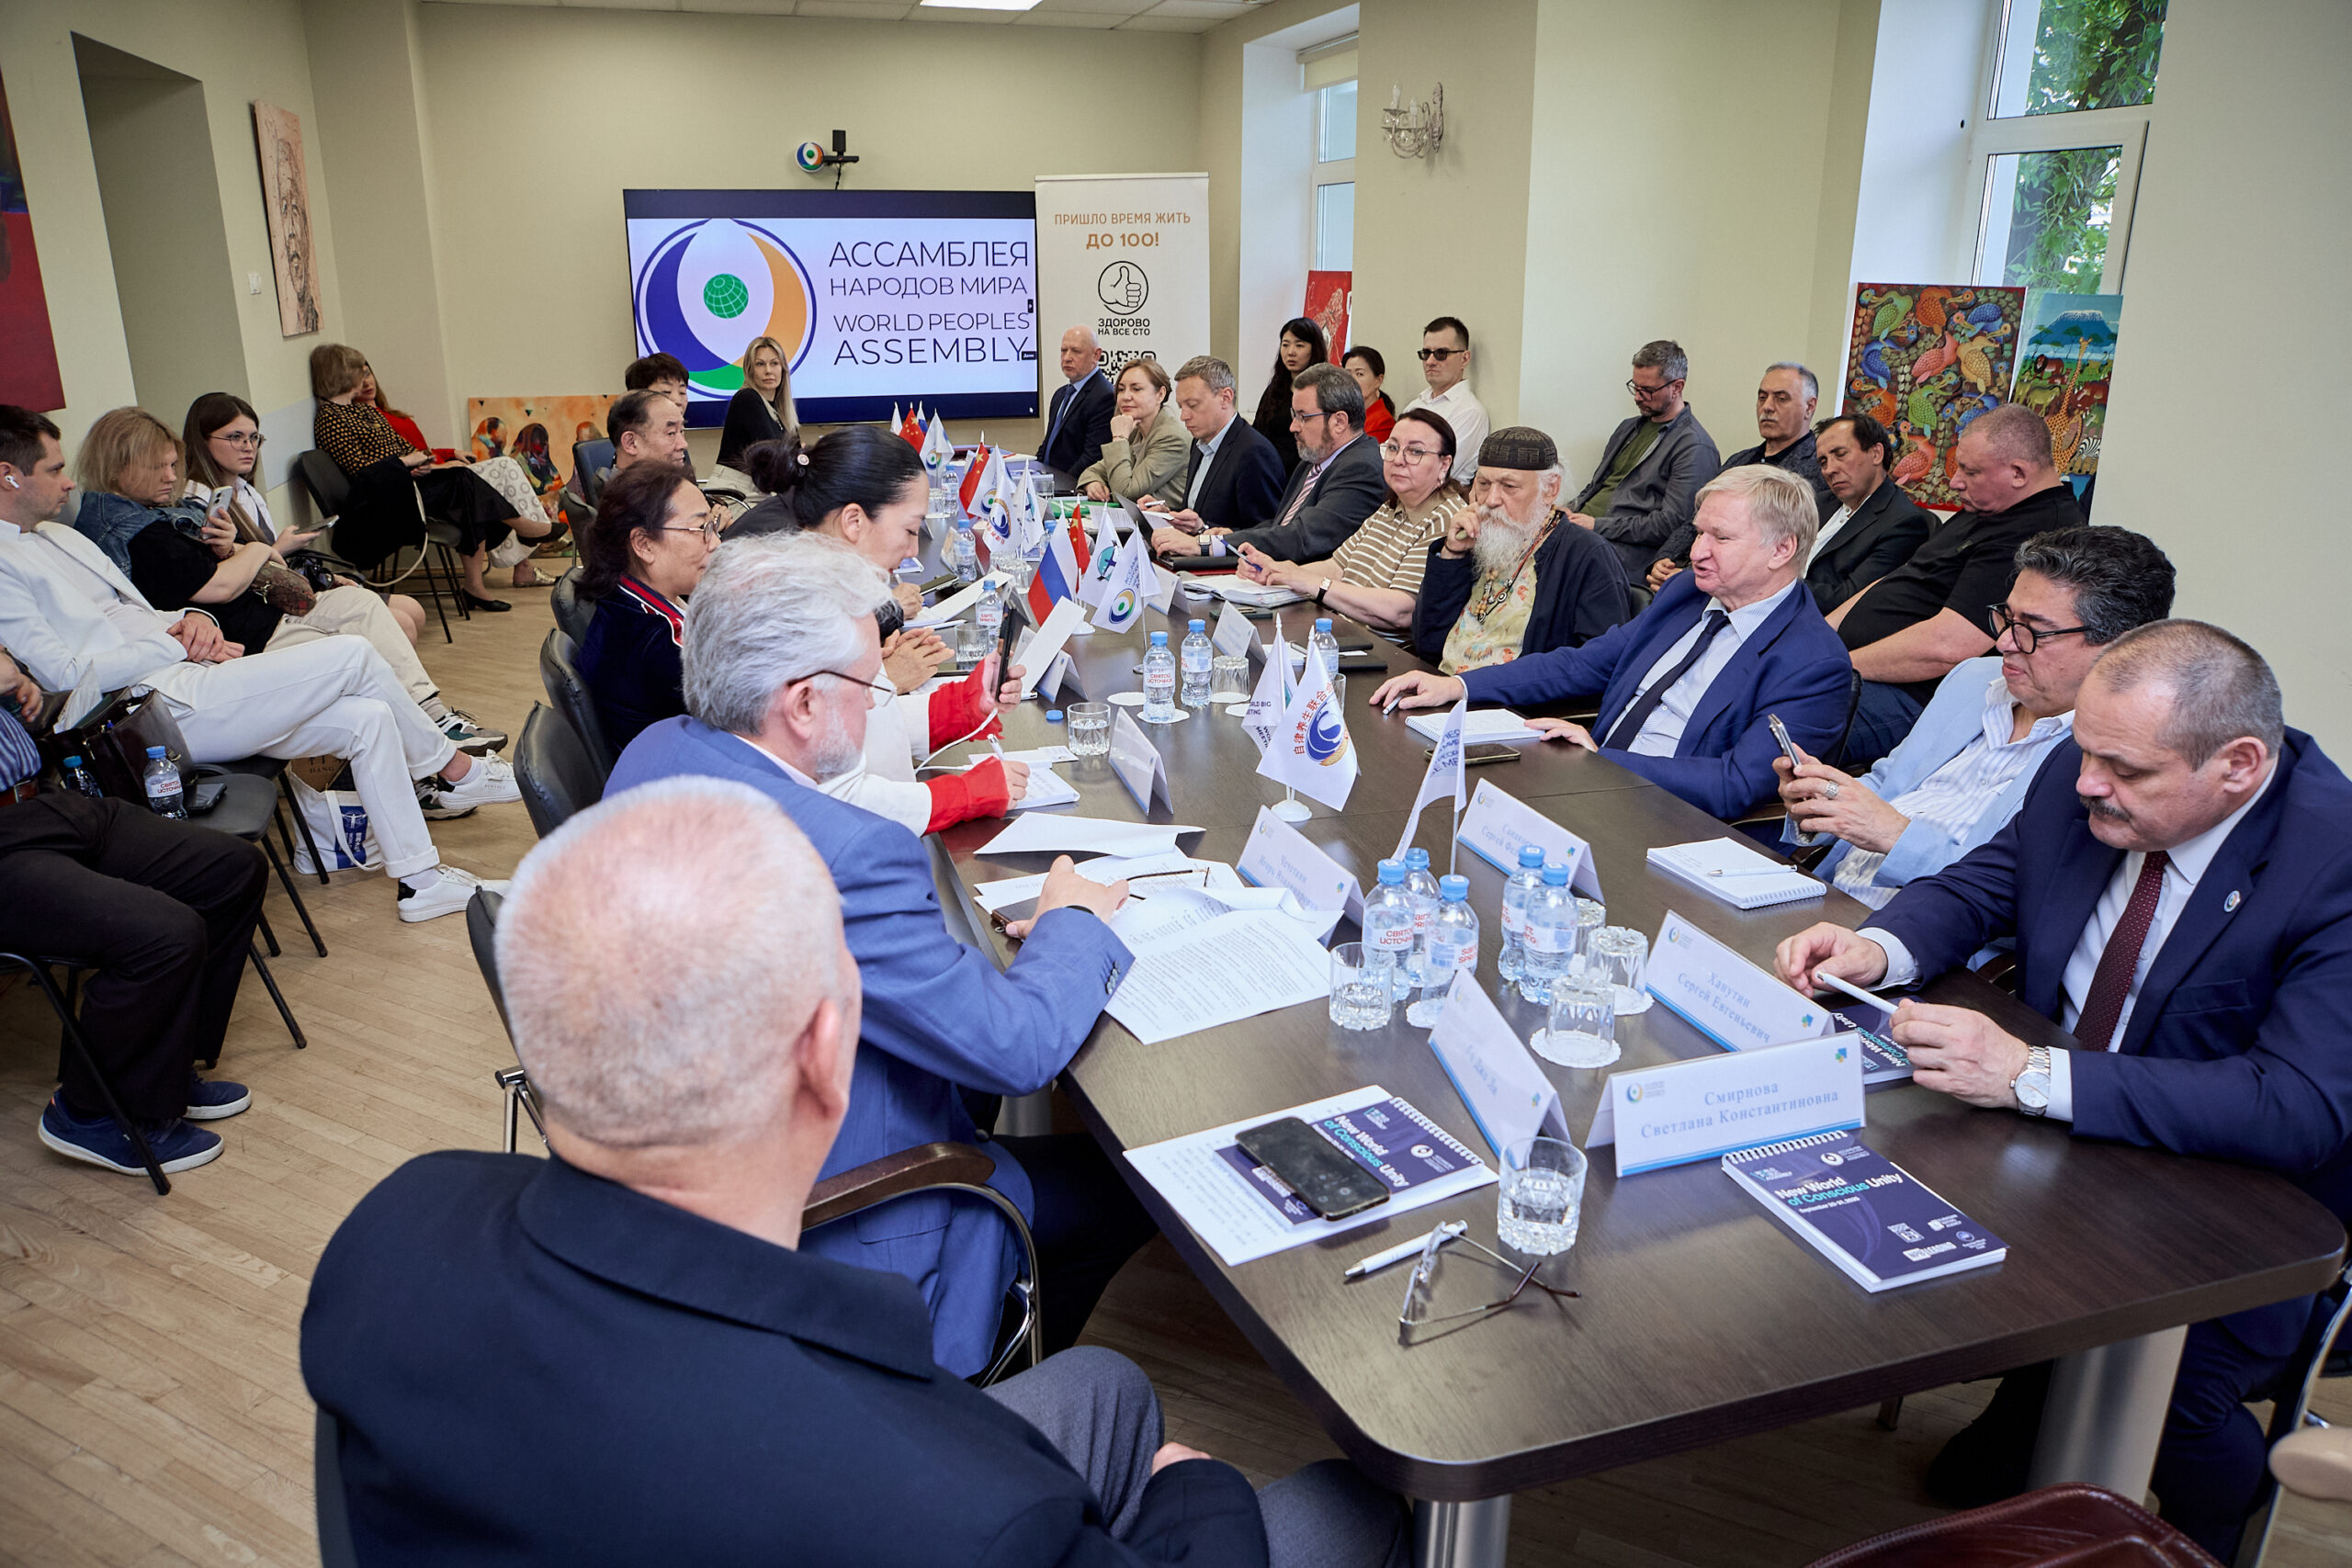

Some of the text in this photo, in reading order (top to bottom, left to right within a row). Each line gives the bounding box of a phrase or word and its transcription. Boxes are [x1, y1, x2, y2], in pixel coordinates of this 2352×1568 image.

[1054, 211, 1191, 225] ПРИШЛО ВРЕМЯ ЖИТЬ
[1085, 232, 1159, 250] ДО 100!
[829, 241, 1029, 268] АССАМБЛЕЯ
[831, 276, 1028, 299] НАРОДОВ МИРА
[833, 312, 1030, 333] WORLD PEOPLES
[1098, 318, 1150, 328] ЗДОРОВО
[1098, 328, 1150, 336] НА ВСЕ СТО
[833, 336, 1029, 366] ASSEMBLY
[1707, 971, 1751, 1009] Ханутин
[1677, 972, 1771, 1043] Сергей Евгеньевич
[1704, 1082, 1780, 1107] Смирнова
[1640, 1090, 1838, 1139] Светлана Константиновна
[1333, 1114, 1361, 1135] New
[1355, 1130, 1389, 1156] World
[1323, 1119, 1340, 1131] of
[1334, 1127, 1384, 1168] Conscious
[1378, 1163, 1410, 1188] Unity
[1774, 1176, 1848, 1199] New World
[1787, 1172, 1904, 1207] of Conscious Unity
